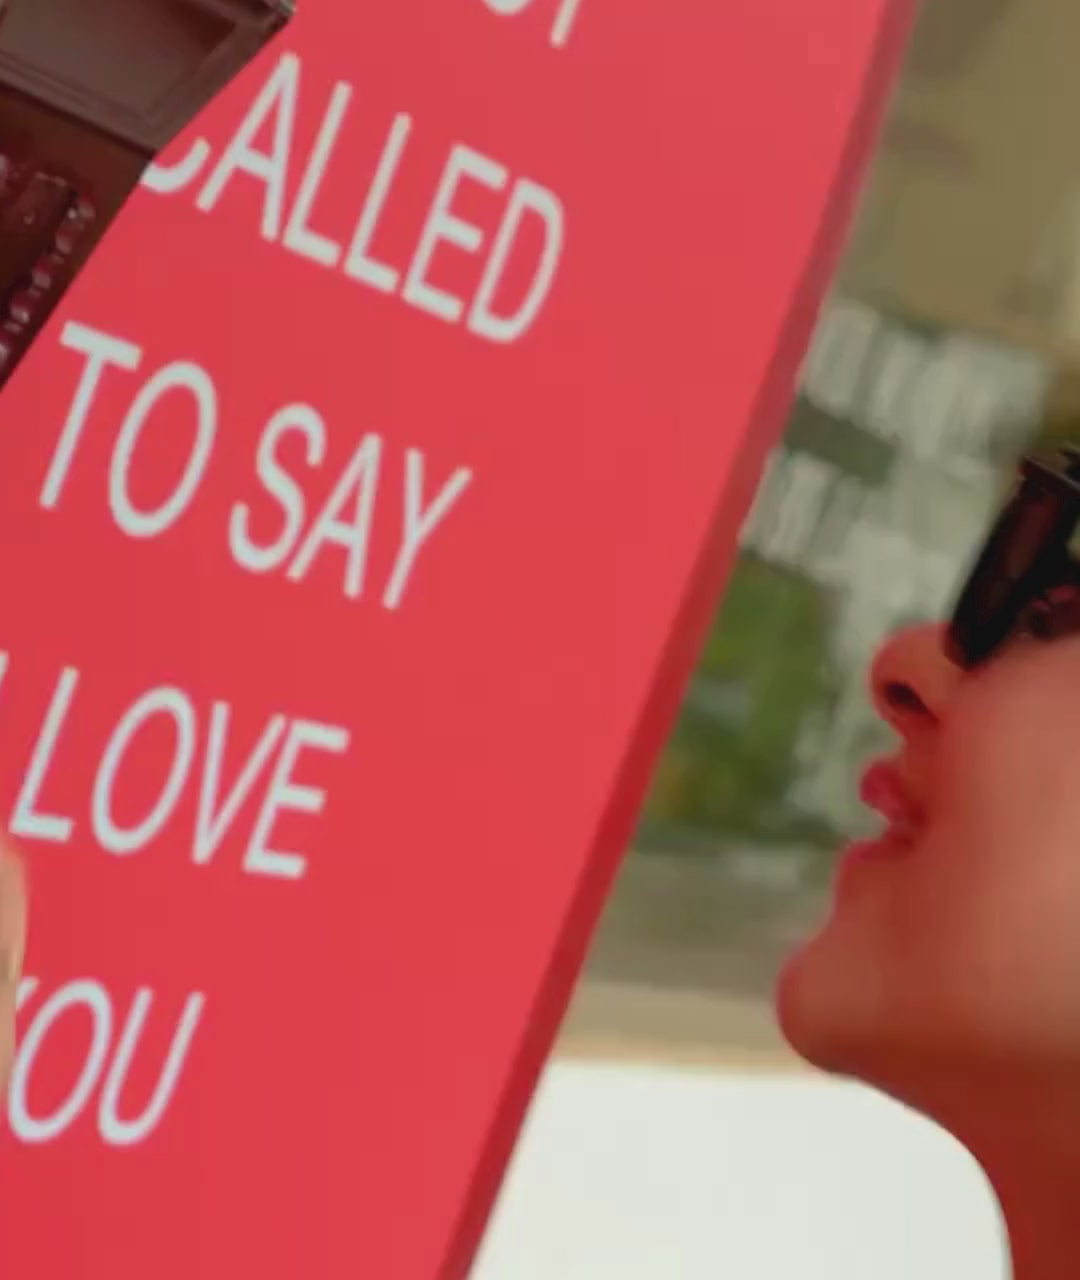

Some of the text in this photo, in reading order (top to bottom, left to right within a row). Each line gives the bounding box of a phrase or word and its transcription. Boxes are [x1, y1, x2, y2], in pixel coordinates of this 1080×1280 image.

[40, 321, 472, 610] TO SAY
[9, 667, 350, 879] LOVE
[8, 977, 204, 1145] OU
